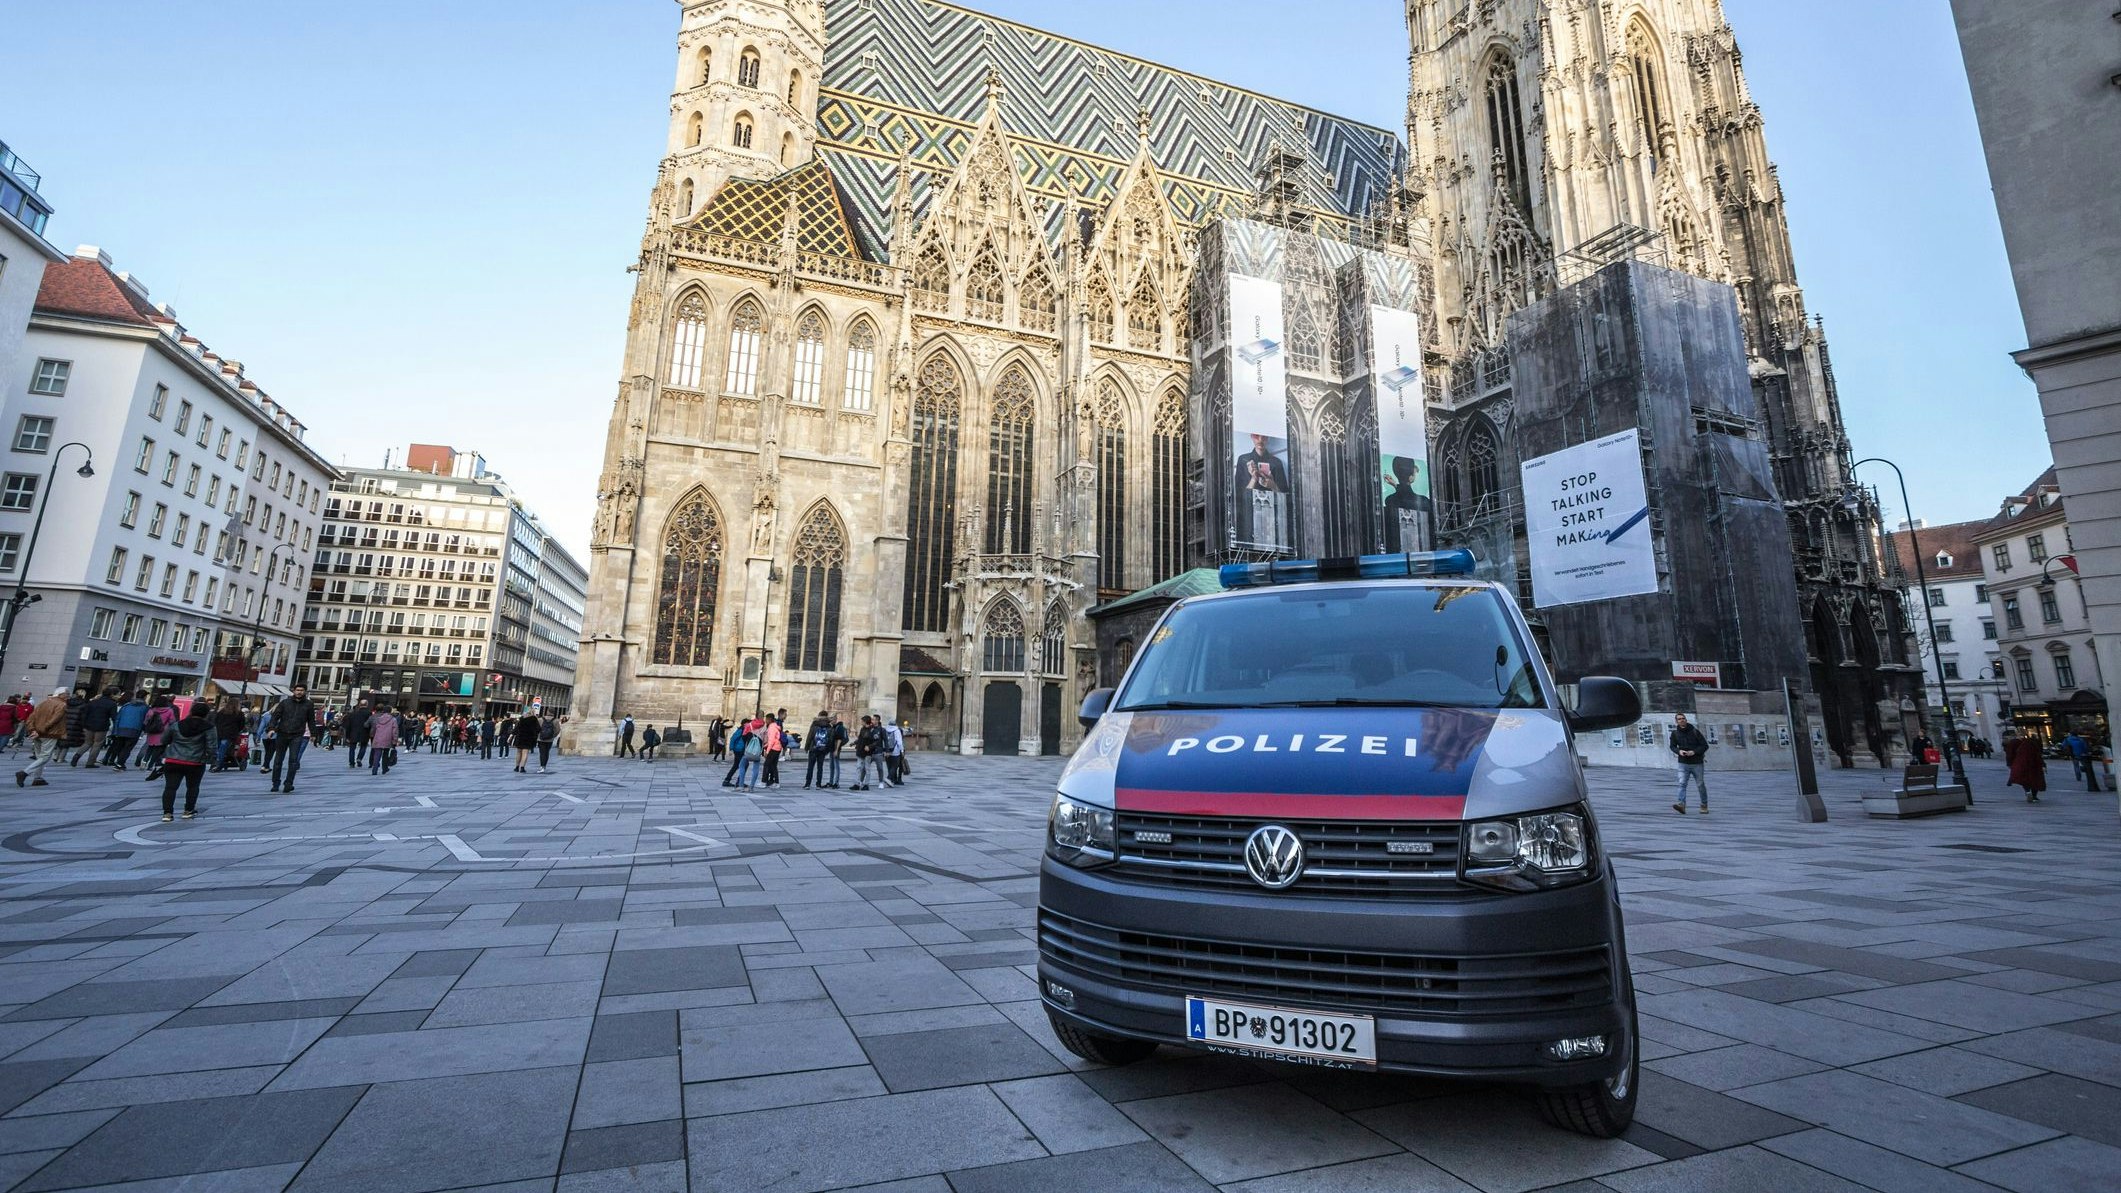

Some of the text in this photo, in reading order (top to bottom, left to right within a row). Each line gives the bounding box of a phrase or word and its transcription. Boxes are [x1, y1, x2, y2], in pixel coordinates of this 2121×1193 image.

[1525, 460, 1546, 470] SAMSUNG
[1561, 472, 1597, 491] STOP
[1551, 487, 1612, 511] TALKING
[1561, 508, 1604, 527] START
[92, 649, 109, 661] Drei
[1684, 665, 1714, 673] XERVON
[1167, 734, 1417, 757] POLIZEI
[1194, 1008, 1357, 1053] A BP 91302
